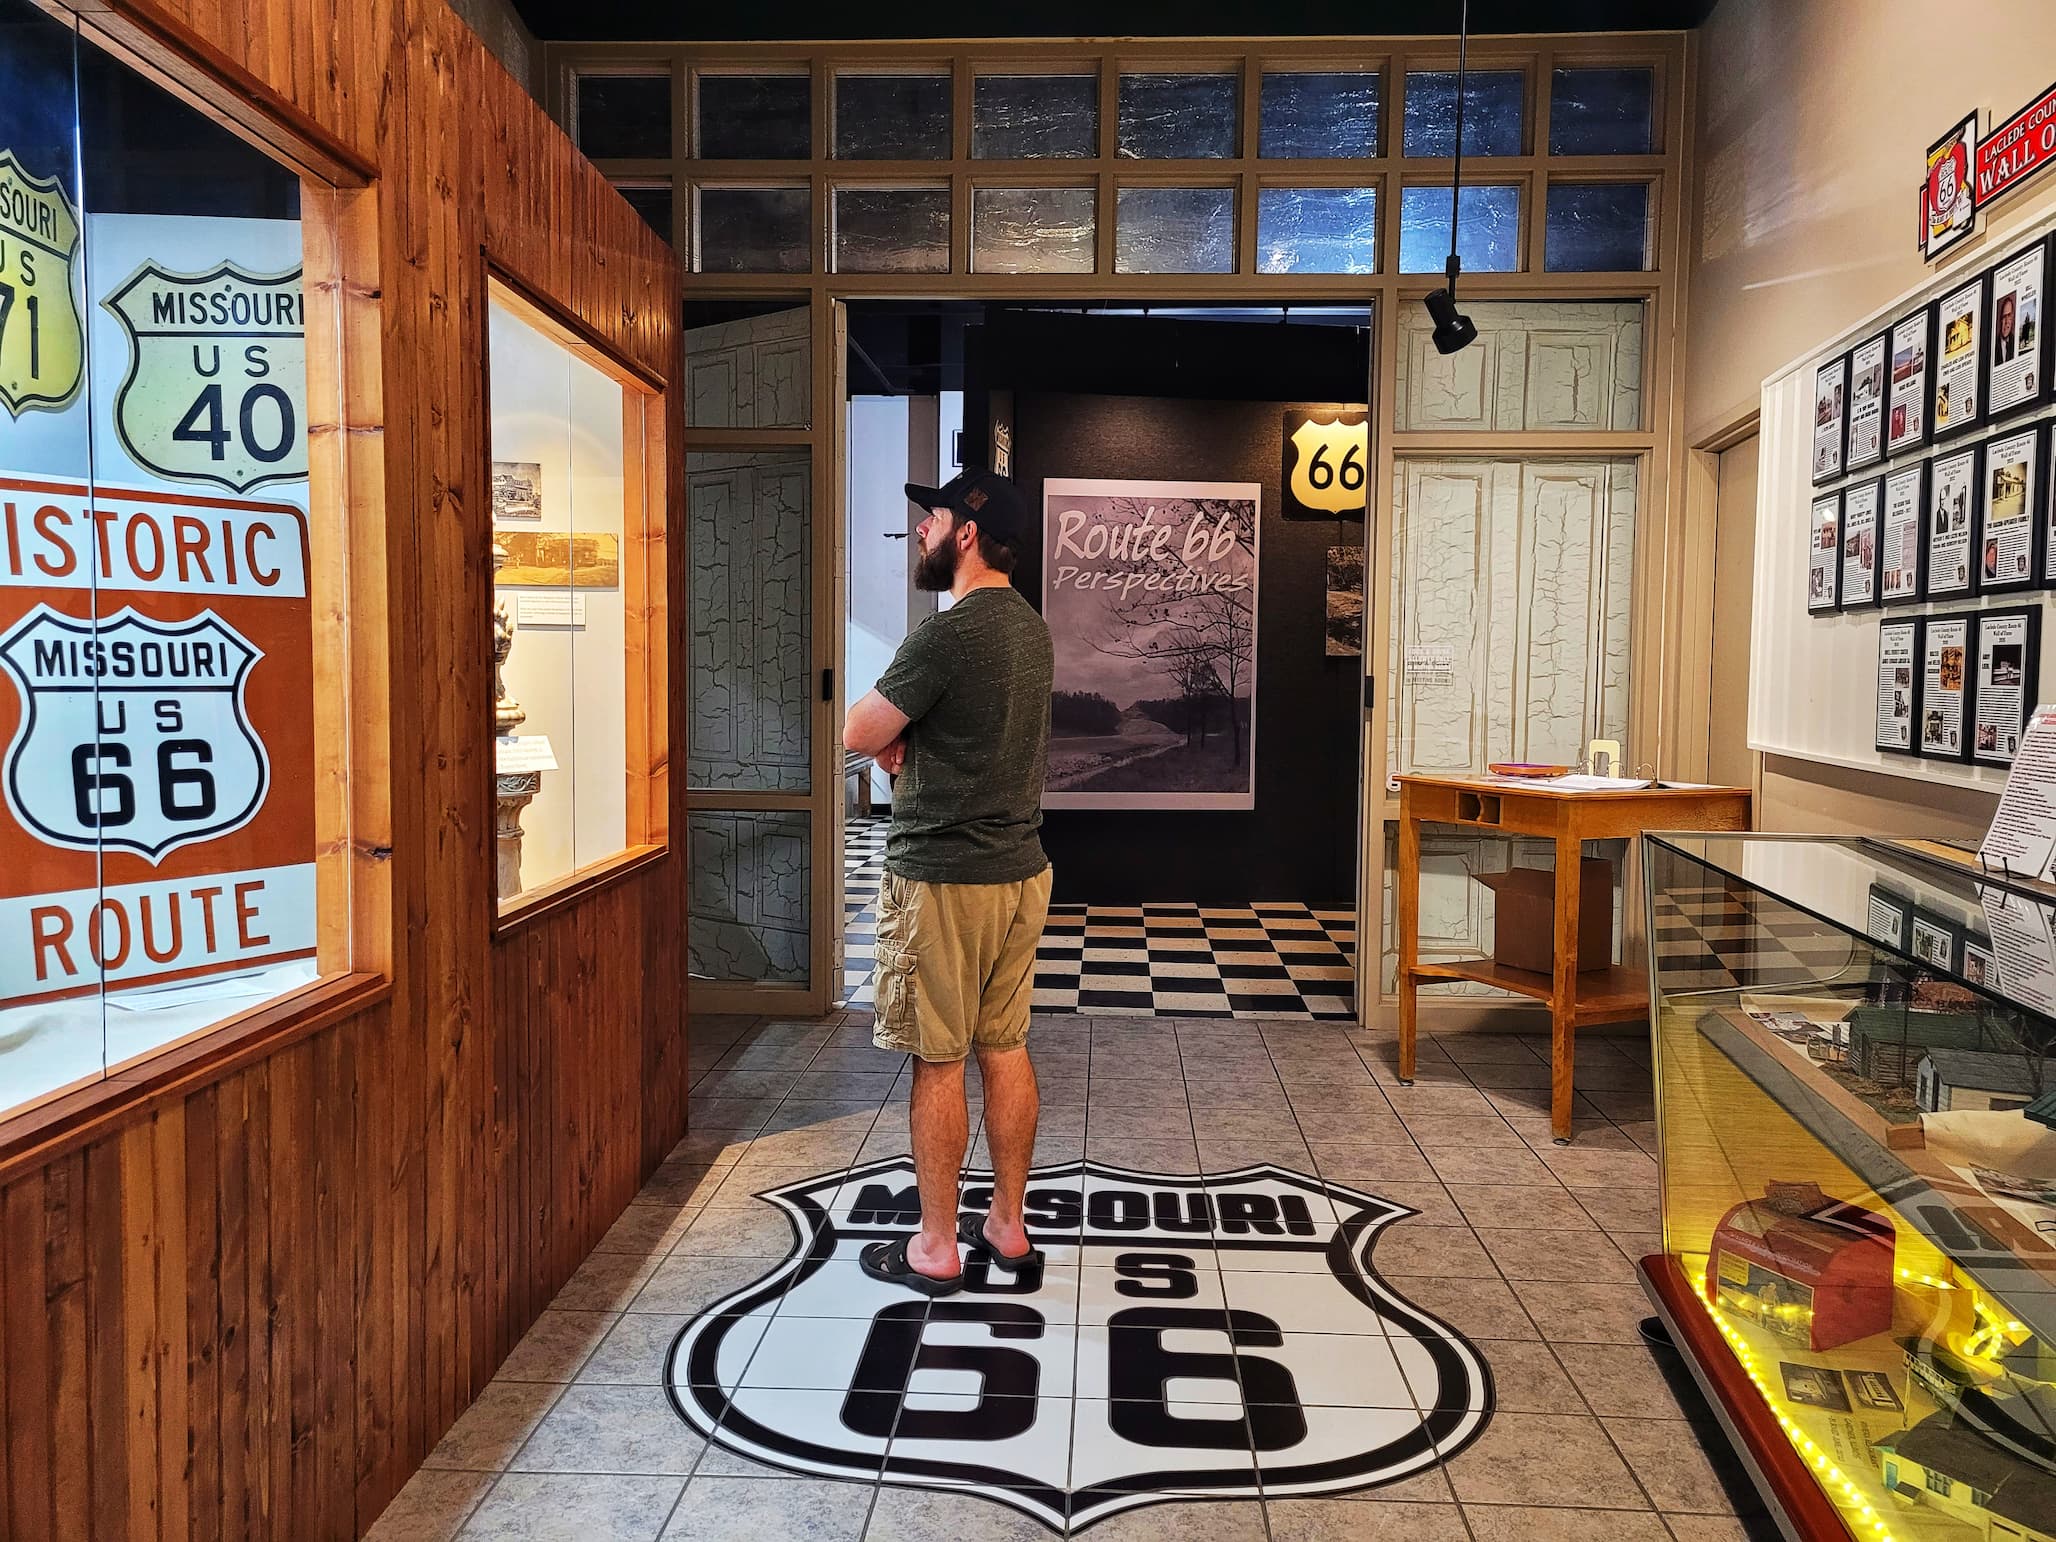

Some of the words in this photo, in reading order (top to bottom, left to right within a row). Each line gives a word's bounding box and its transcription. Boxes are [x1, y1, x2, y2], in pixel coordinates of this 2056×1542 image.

[1980, 139, 2036, 196] WALL
[1984, 122, 2025, 164] LACLEDE
[1940, 175, 1954, 202] 66
[152, 292, 305, 326] MISSOURI
[172, 383, 295, 462] 40
[1308, 443, 1365, 491] 66
[1053, 506, 1171, 562] Route
[1182, 511, 1237, 562] 66
[1053, 565, 1249, 600] Perspectives
[34, 639, 228, 677] MISSOURI
[71, 739, 216, 828] 66
[31, 880, 270, 981] ROUTE
[839, 1301, 1308, 1451] 66
